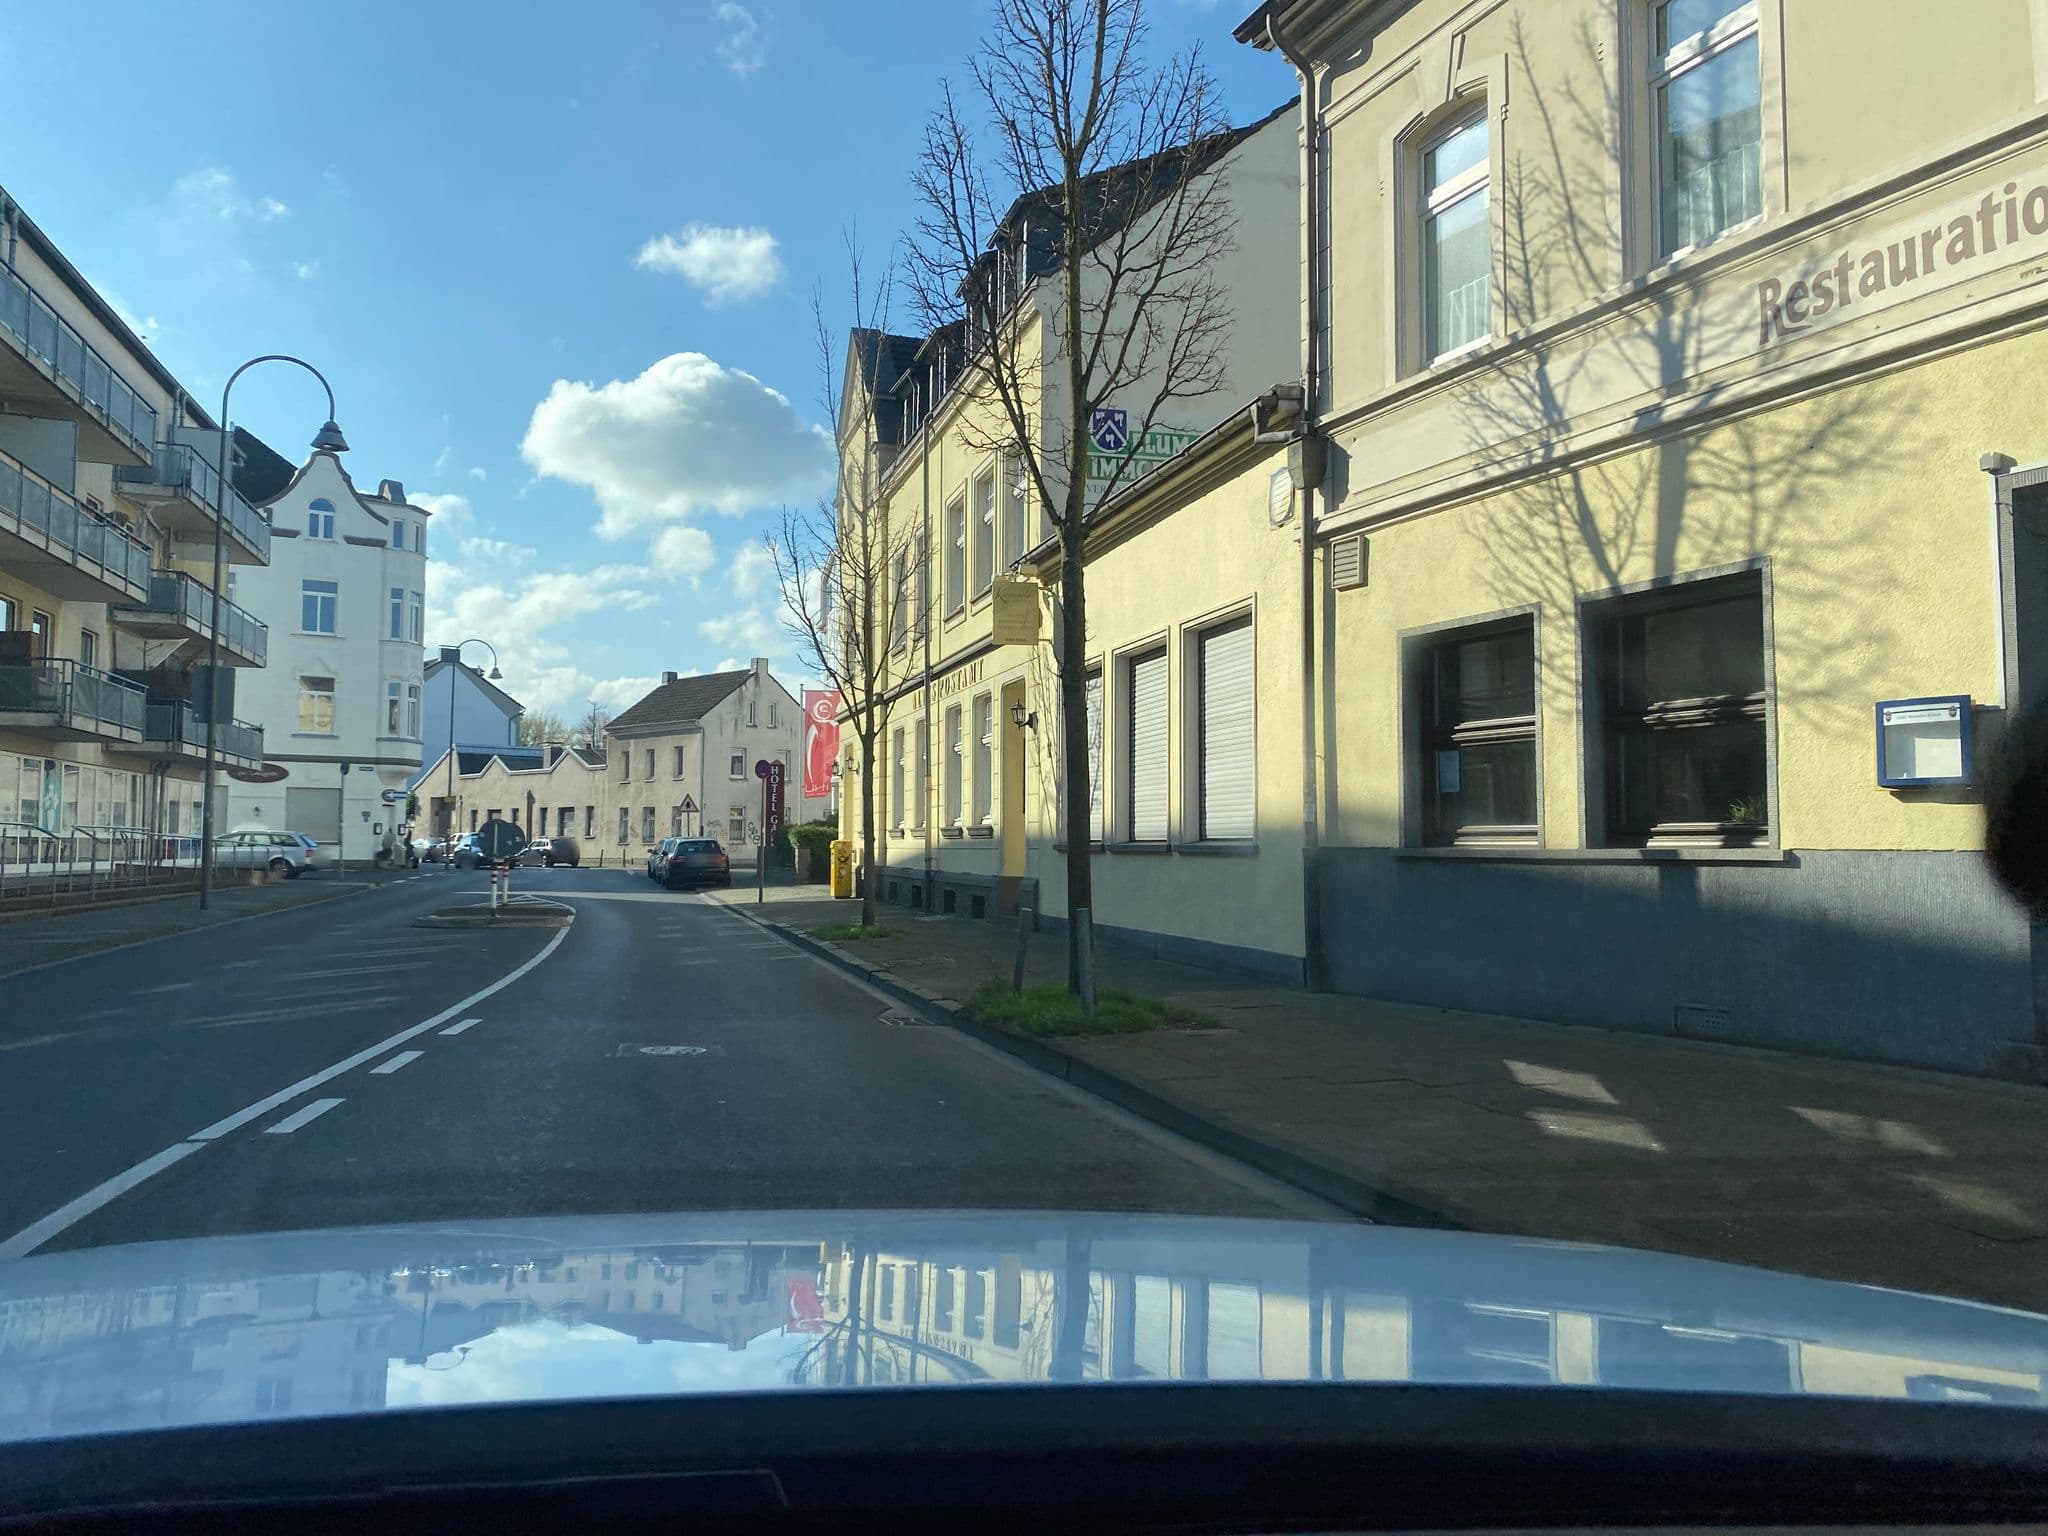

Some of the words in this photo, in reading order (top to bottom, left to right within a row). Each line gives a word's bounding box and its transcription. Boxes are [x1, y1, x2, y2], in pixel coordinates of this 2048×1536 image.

[1758, 182, 2048, 346] Restauratio
[1091, 457, 1160, 479] IMMO
[940, 658, 984, 699] POSTAMT
[770, 766, 779, 811] HOTEL
